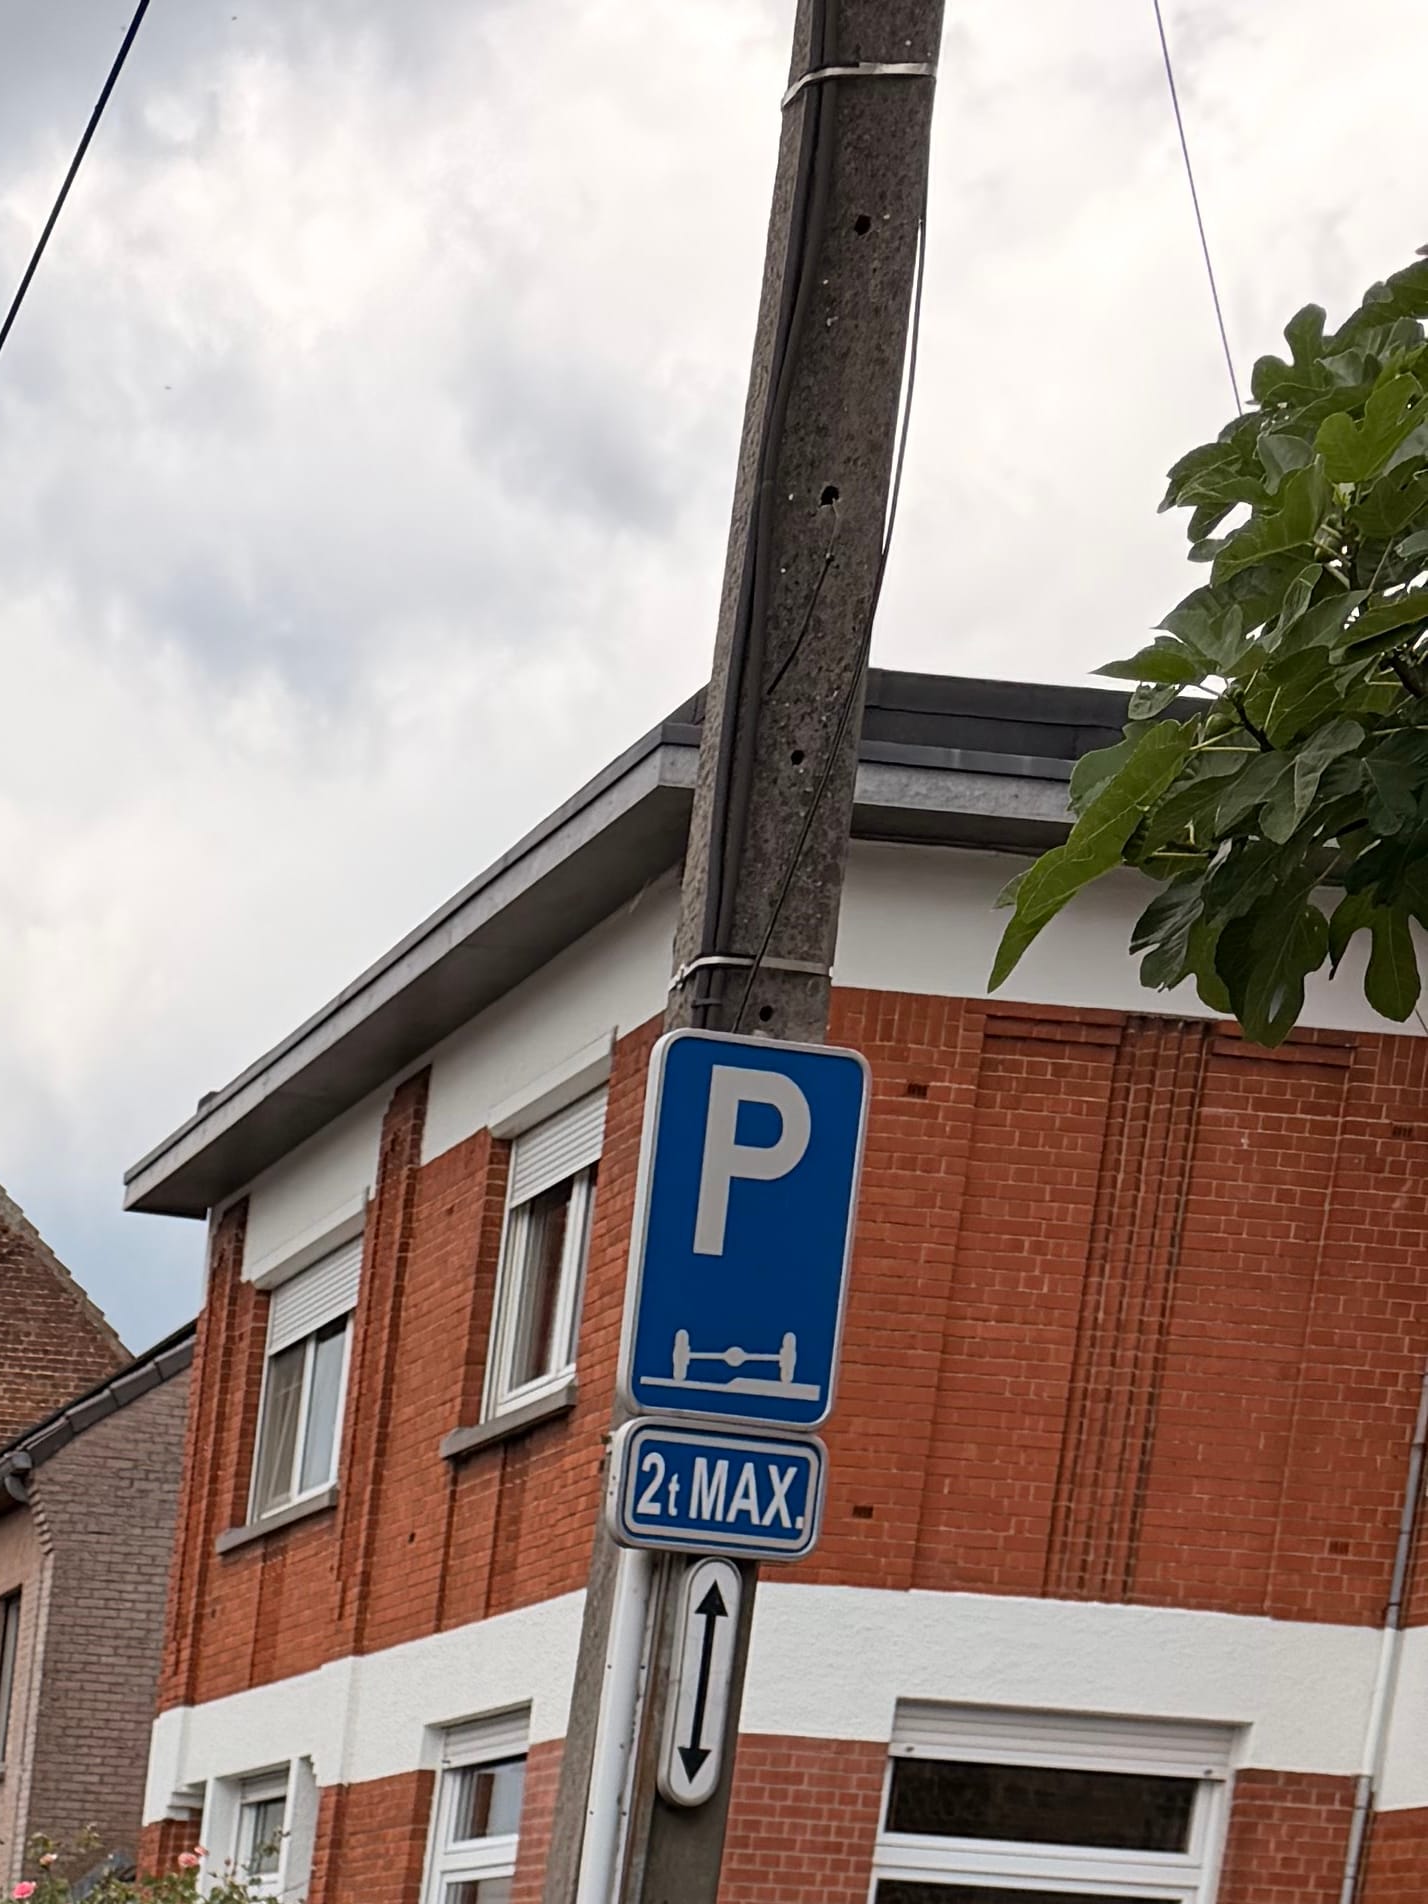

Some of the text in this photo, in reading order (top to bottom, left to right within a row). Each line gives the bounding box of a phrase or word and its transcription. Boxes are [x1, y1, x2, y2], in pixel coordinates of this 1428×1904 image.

[693, 1064, 811, 1256] P
[636, 1452, 804, 1530] 2t MAX.
